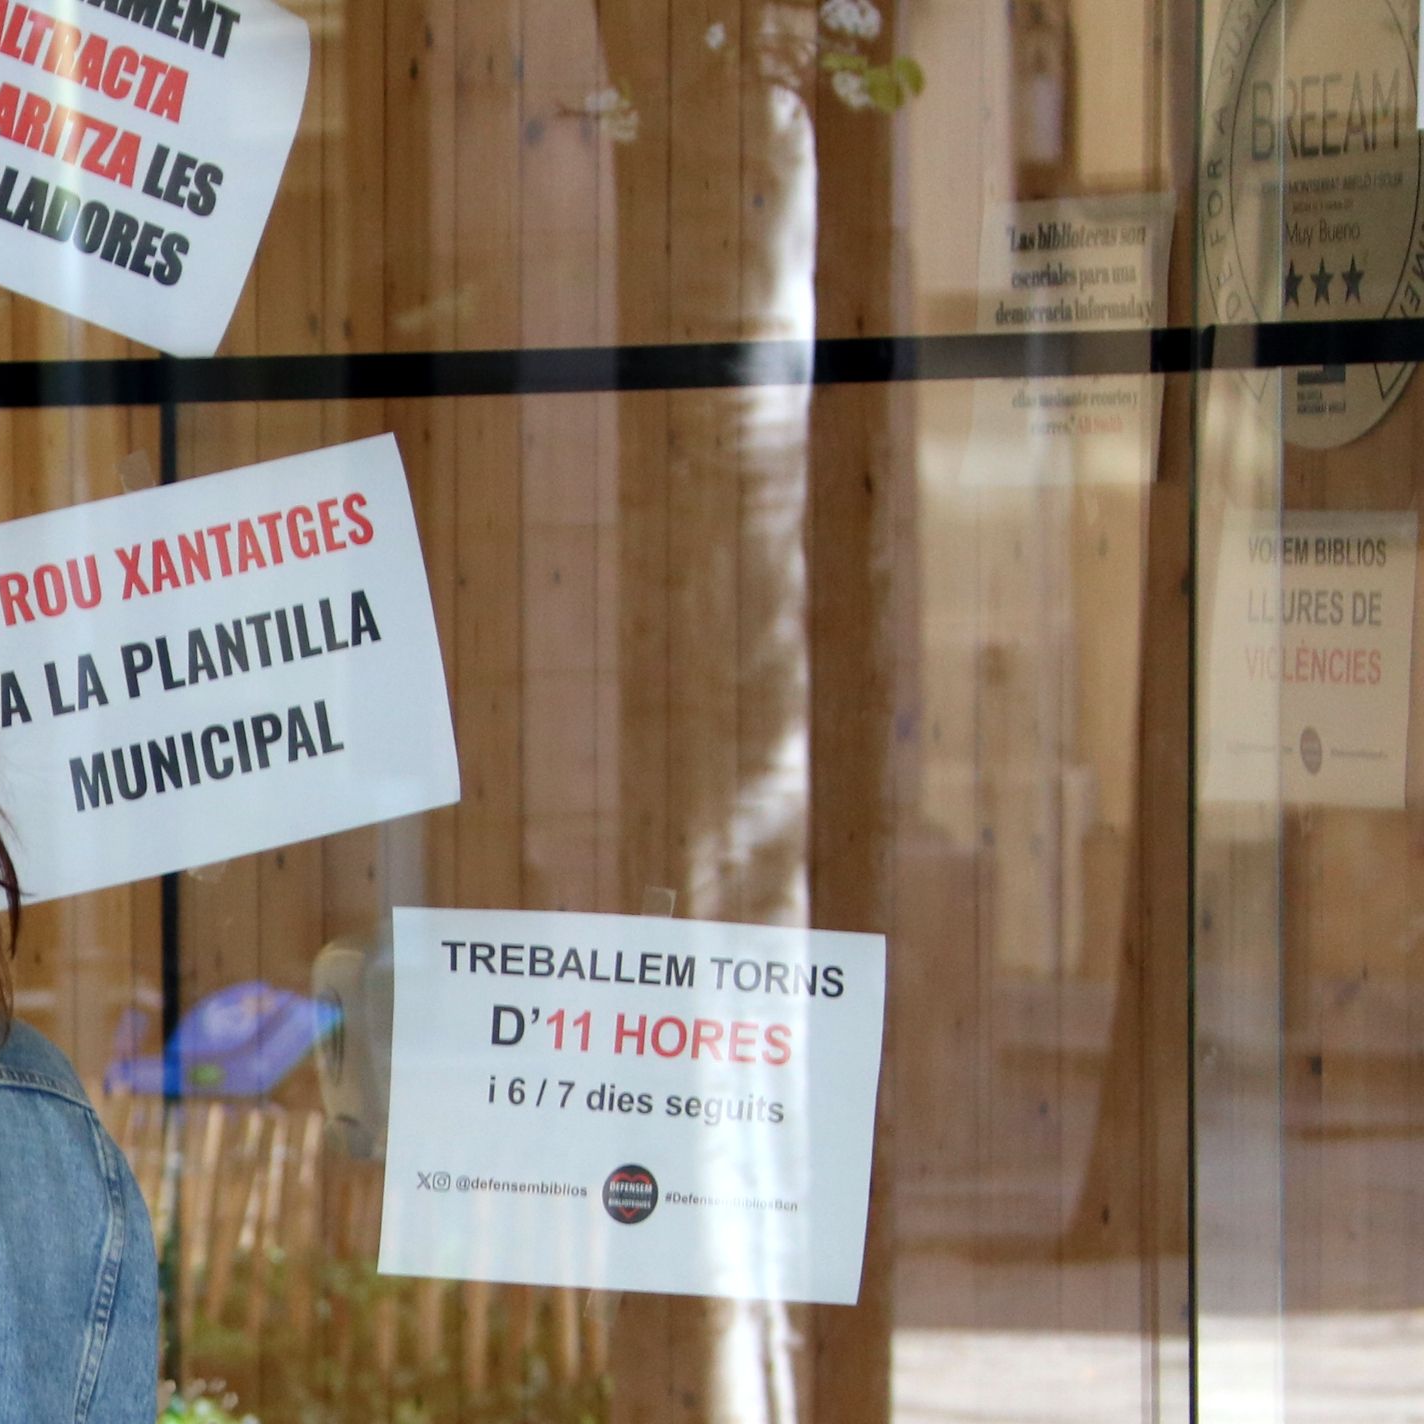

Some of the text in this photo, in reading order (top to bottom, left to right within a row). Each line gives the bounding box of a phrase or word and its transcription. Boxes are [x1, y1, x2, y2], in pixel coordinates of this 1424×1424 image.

[1252, 69, 1399, 161] BREEAM
[142, 145, 224, 217] LES
[1320, 219, 1360, 242] Bueno
[113, 491, 375, 601] XANTATGES
[1314, 537, 1387, 567] BIBLIOS
[1352, 591, 1383, 627] DE
[0, 589, 382, 729] A LA PLANTILLA
[69, 699, 345, 812] MUNICIPAL
[441, 940, 845, 998] TREBALLEM TORNS
[613, 1013, 792, 1066] HORES
[488, 1076, 496, 1104] i
[508, 1077, 526, 1105] 6
[558, 1080, 576, 1109] 7
[586, 1083, 654, 1115] dies
[665, 1090, 785, 1126] seguits
[455, 1175, 588, 1197] @defensembiblios
